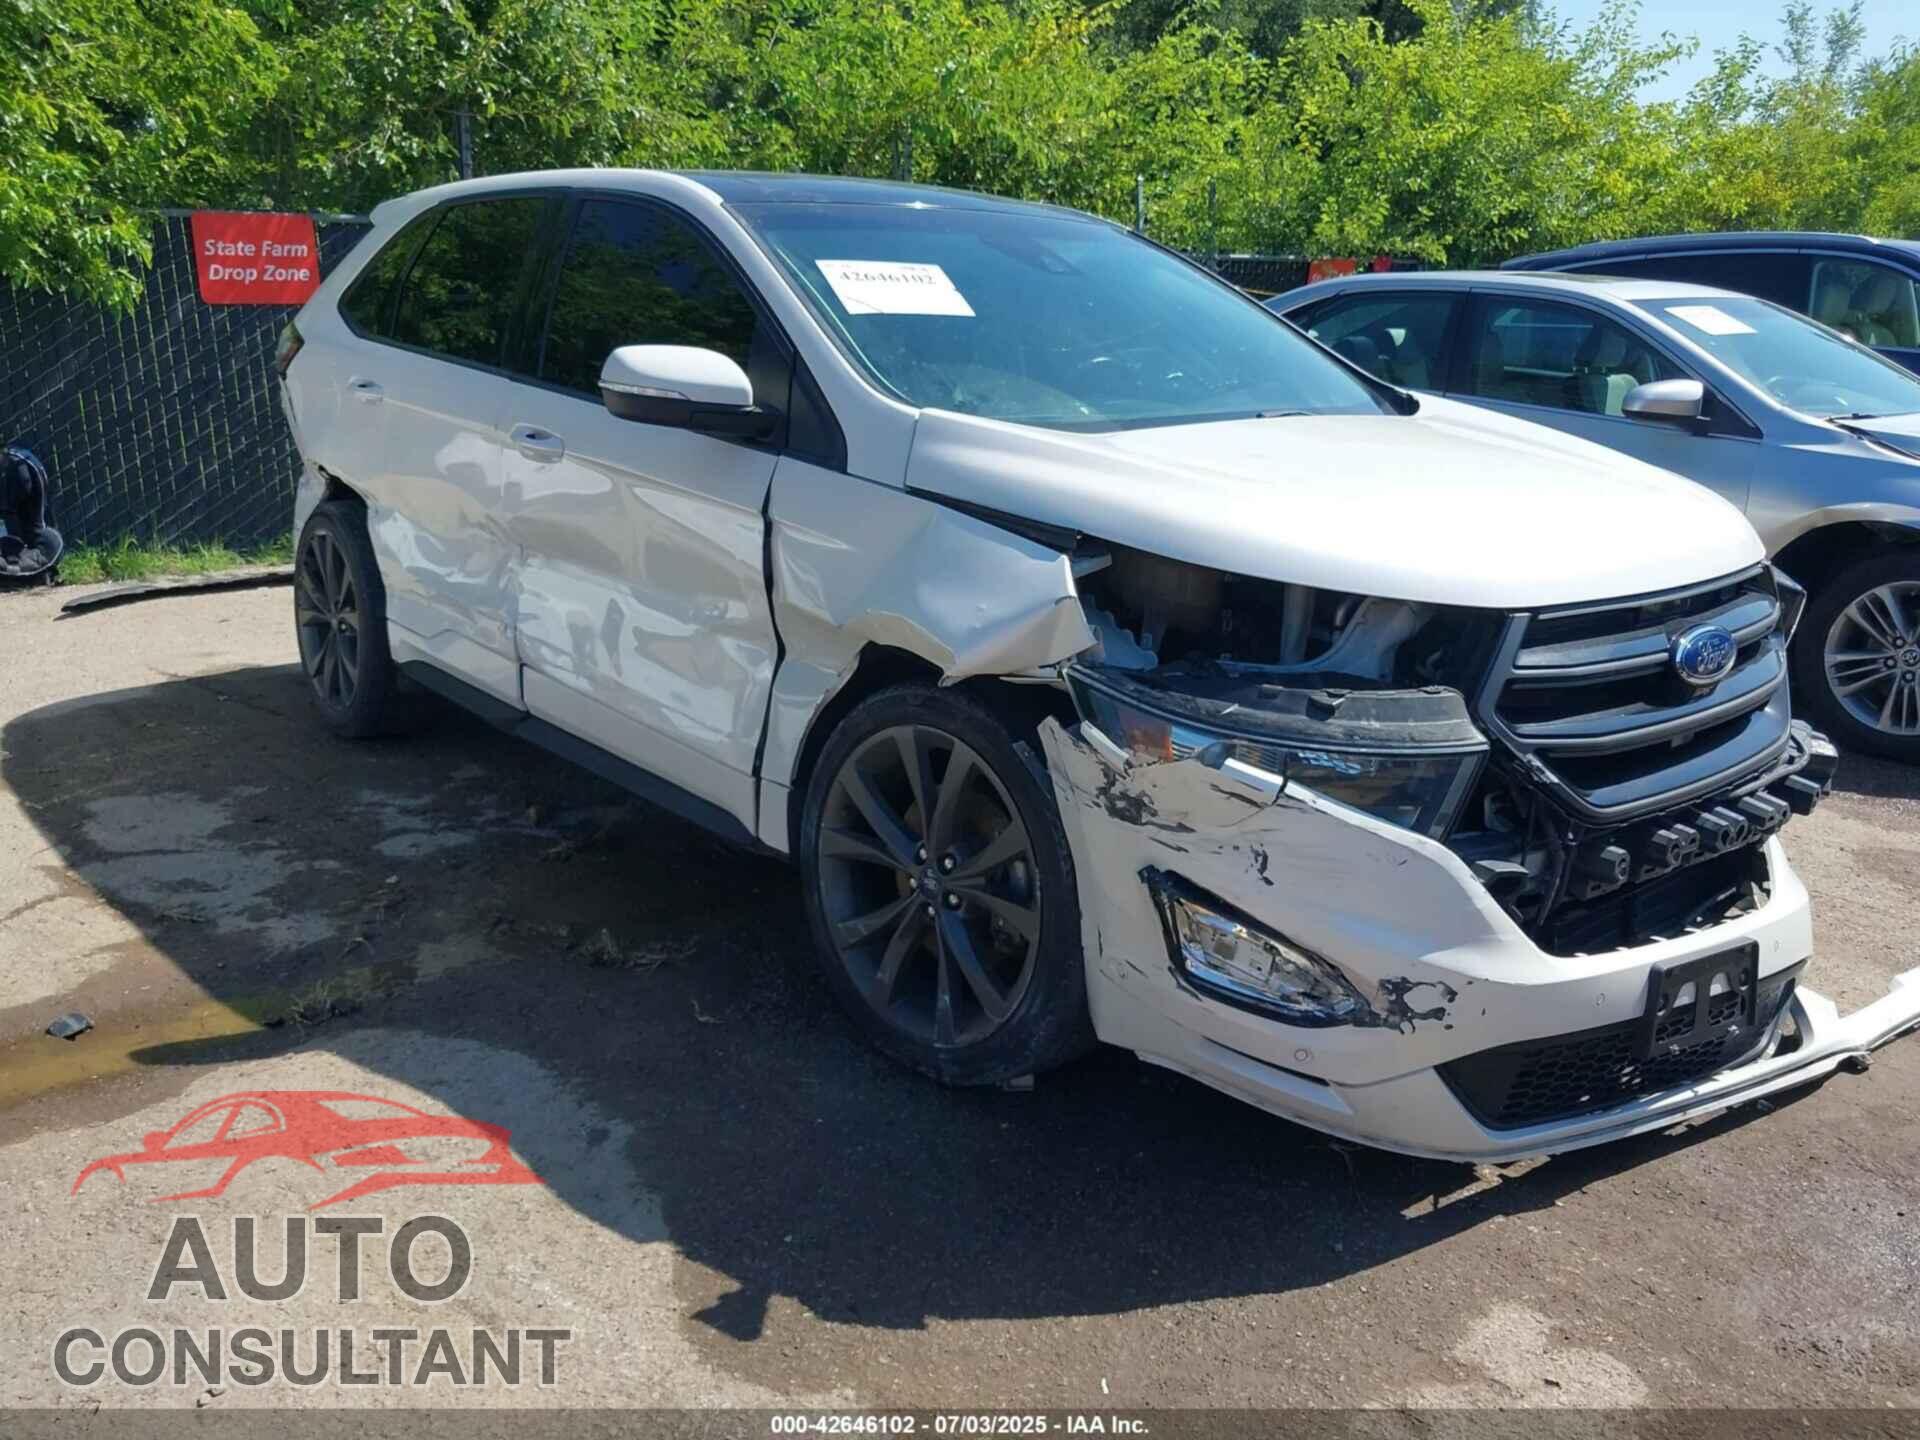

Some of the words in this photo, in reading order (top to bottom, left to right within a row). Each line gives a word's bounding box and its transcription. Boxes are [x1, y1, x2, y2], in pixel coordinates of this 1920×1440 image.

[204, 239, 256, 257] State
[261, 240, 308, 257] Farm
[208, 264, 257, 285] Drop
[263, 264, 310, 281] Zone
